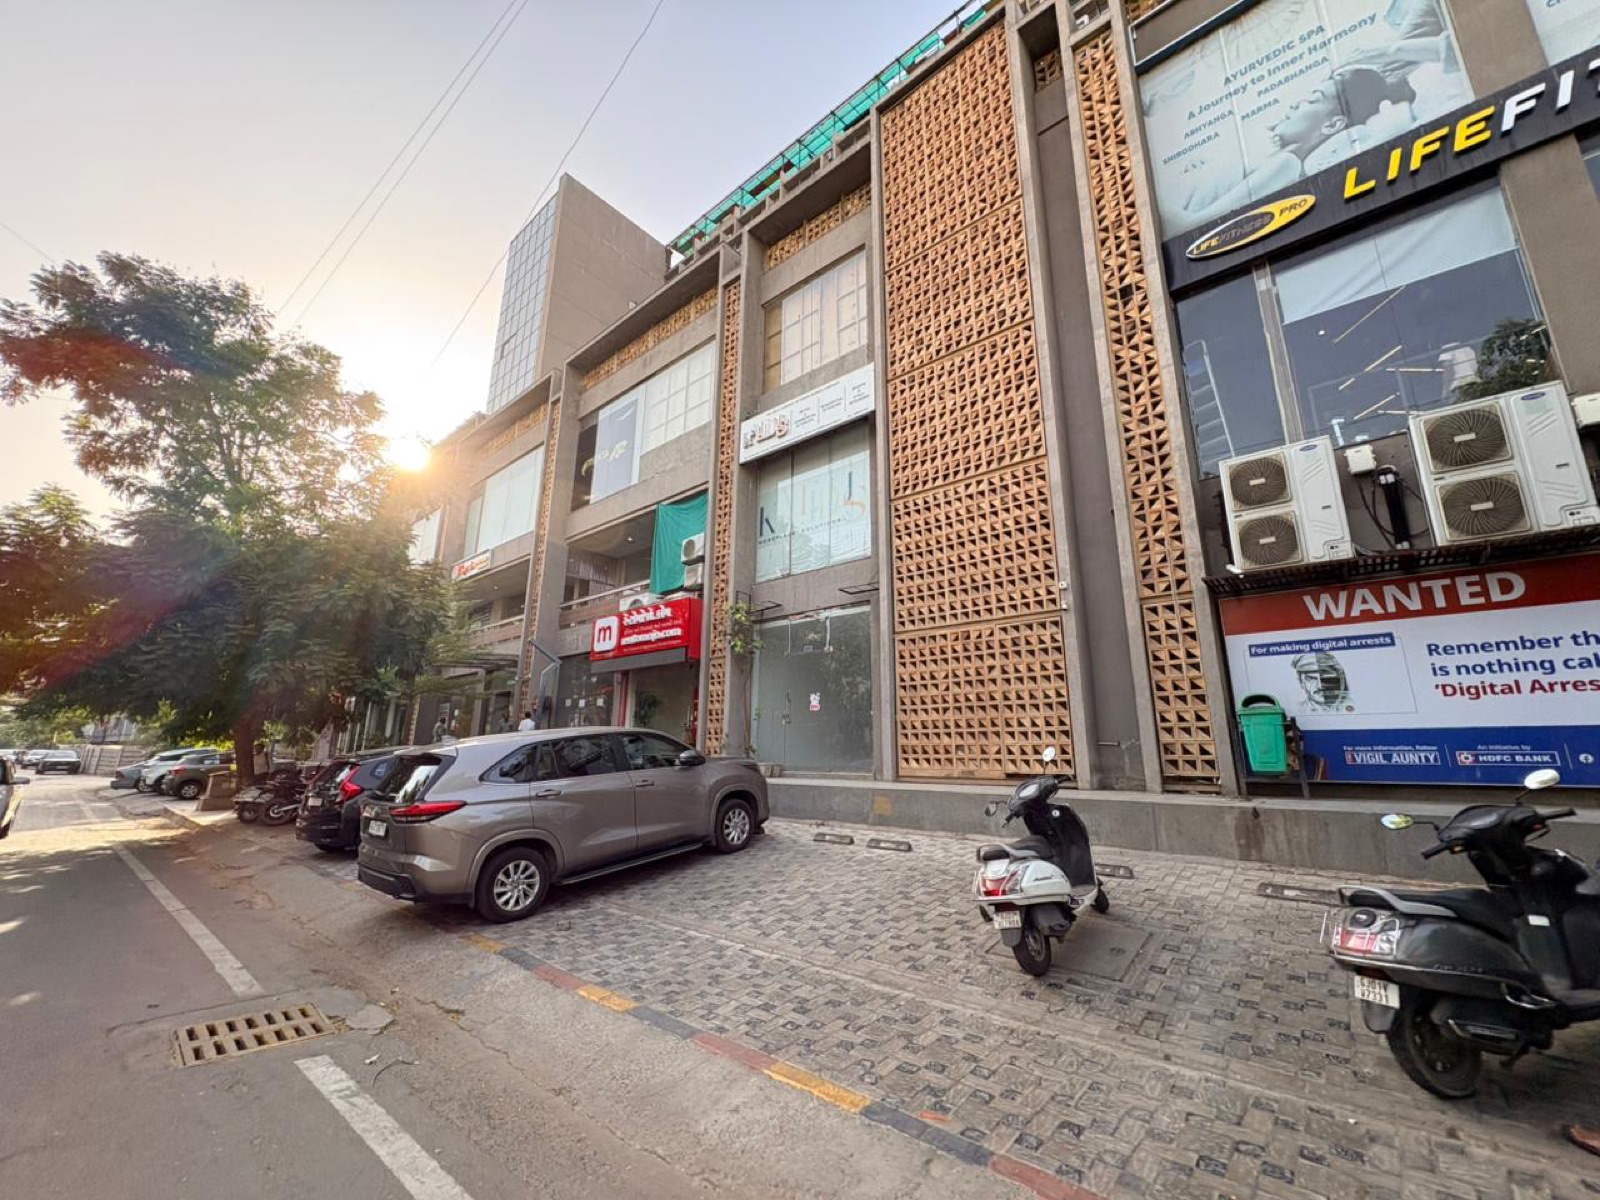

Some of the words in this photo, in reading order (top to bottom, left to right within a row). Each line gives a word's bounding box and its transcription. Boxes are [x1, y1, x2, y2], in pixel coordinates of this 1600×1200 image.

[1224, 40, 1296, 86] AYURVEDIC
[1299, 25, 1325, 44] SPA
[1187, 110, 1196, 121] A
[1198, 83, 1248, 115] Journey
[1251, 73, 1265, 86] to
[1267, 51, 1305, 77] Inner
[1307, 13, 1377, 56] Harmony
[1241, 98, 1280, 121] MARMA
[1279, 198, 1308, 218] PRO
[1303, 571, 1526, 621] WANTED
[1251, 645, 1267, 655] For
[1269, 642, 1310, 653] making
[1311, 637, 1348, 651] digital
[1349, 636, 1391, 646] arrests
[1426, 635, 1564, 657] Remember
[1430, 662, 1450, 677] is
[1455, 657, 1556, 676] nothing
[1529, 679, 1600, 695] Arres
[1391, 752, 1436, 765] AUNTY
[1478, 754, 1512, 763] HDFC
[1515, 754, 1552, 763] BANK
